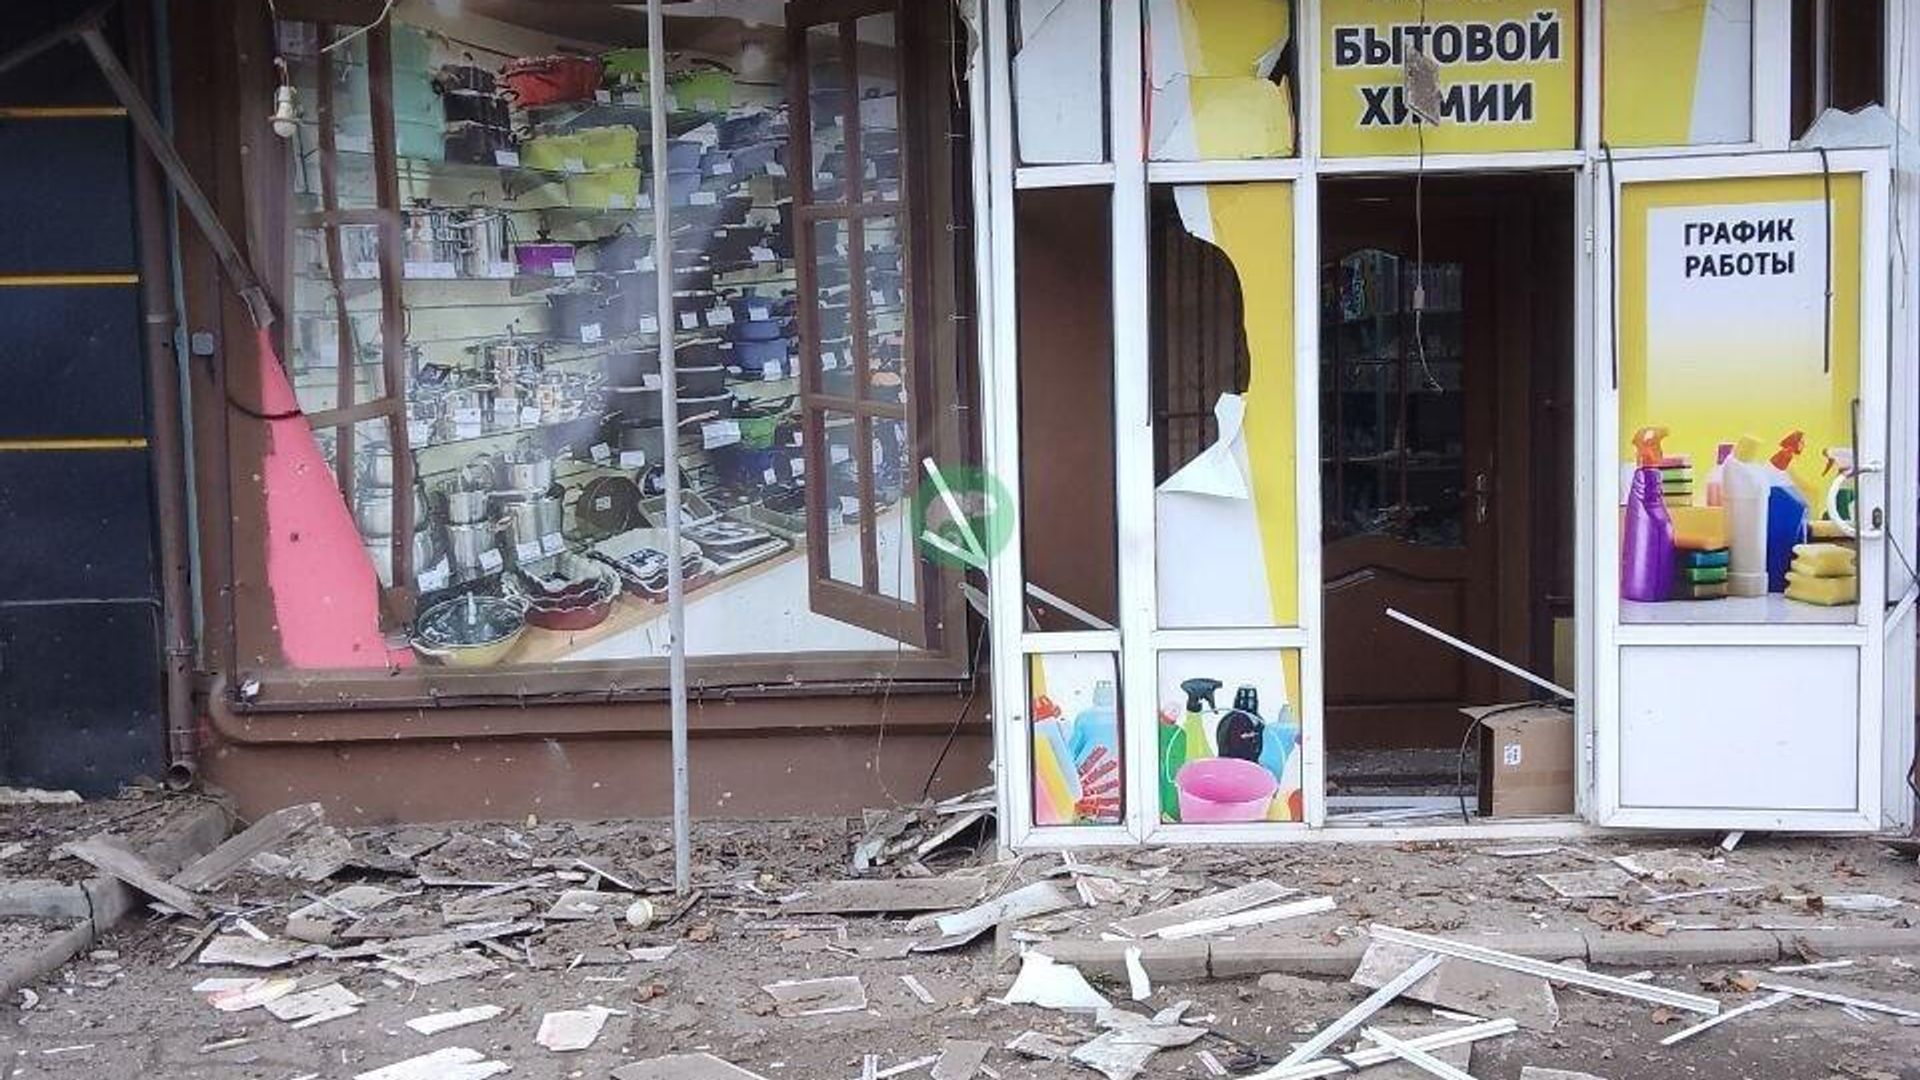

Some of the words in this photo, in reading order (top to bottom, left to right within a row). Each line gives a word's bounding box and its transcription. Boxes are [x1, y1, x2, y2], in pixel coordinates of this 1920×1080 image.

[1334, 12, 1560, 66] БЫТОВОЙ
[1684, 218, 1795, 245] ГРАФИК
[1685, 251, 1795, 278] РАБОТЫ
